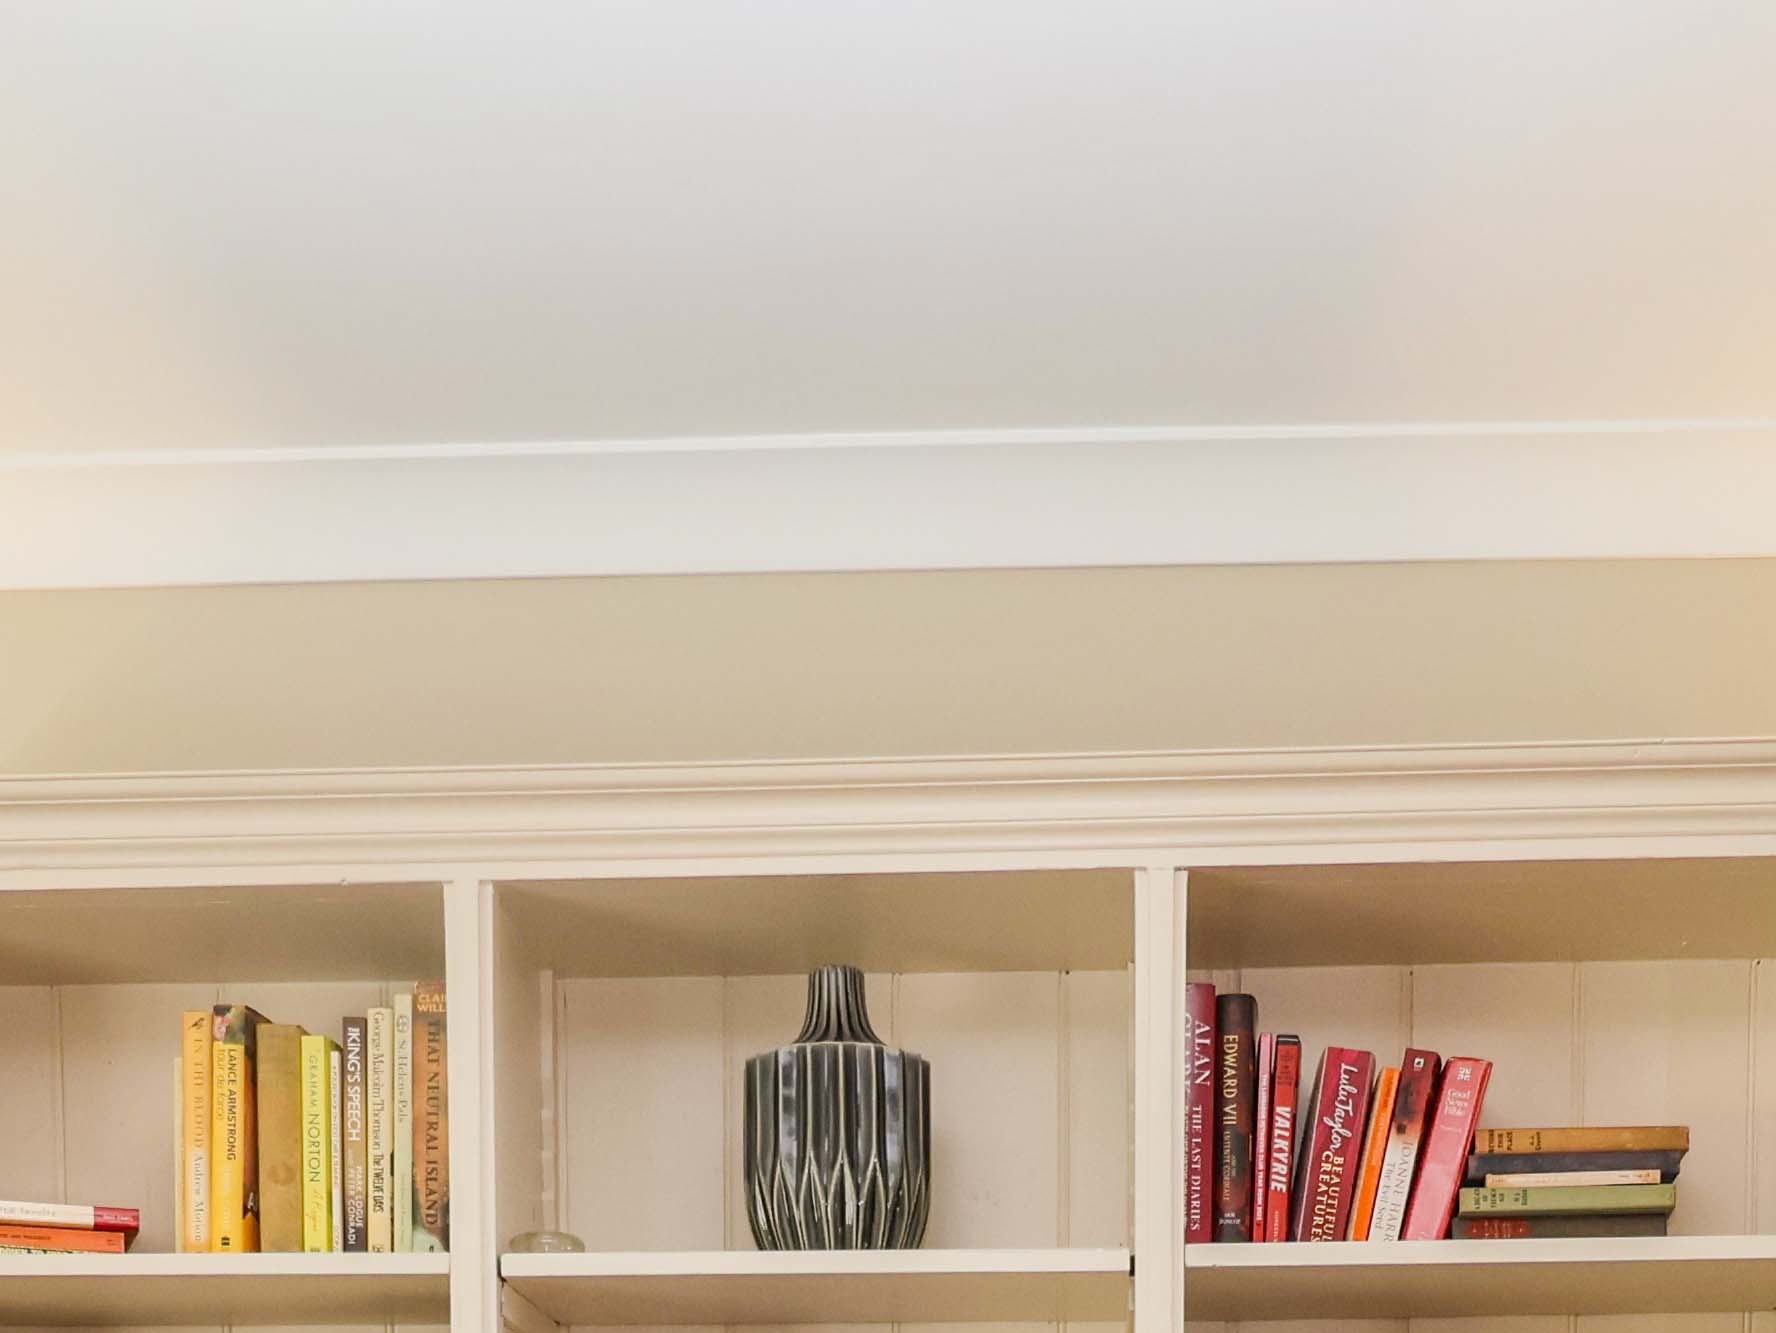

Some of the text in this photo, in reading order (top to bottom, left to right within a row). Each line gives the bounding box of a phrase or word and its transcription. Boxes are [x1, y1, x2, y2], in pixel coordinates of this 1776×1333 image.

[194, 1062, 203, 1089] THE
[347, 1032, 361, 1141] KING'S SPEECH
[1194, 1020, 1211, 1087] ALAN
[1223, 1035, 1238, 1125] EDWARD VII
[193, 1096, 204, 1148] BLOOD
[227, 1048, 237, 1160] LANCE ARMSTRONG
[425, 1072, 441, 1151] NEUTRAL
[1324, 1063, 1358, 1152] Lulu Taylor
[308, 1113, 321, 1182] NORTON
[1190, 1104, 1203, 1231] THE LAST DIARIES
[1269, 1104, 1292, 1193] VALKYRIE
[424, 1160, 439, 1225] ISLAND
